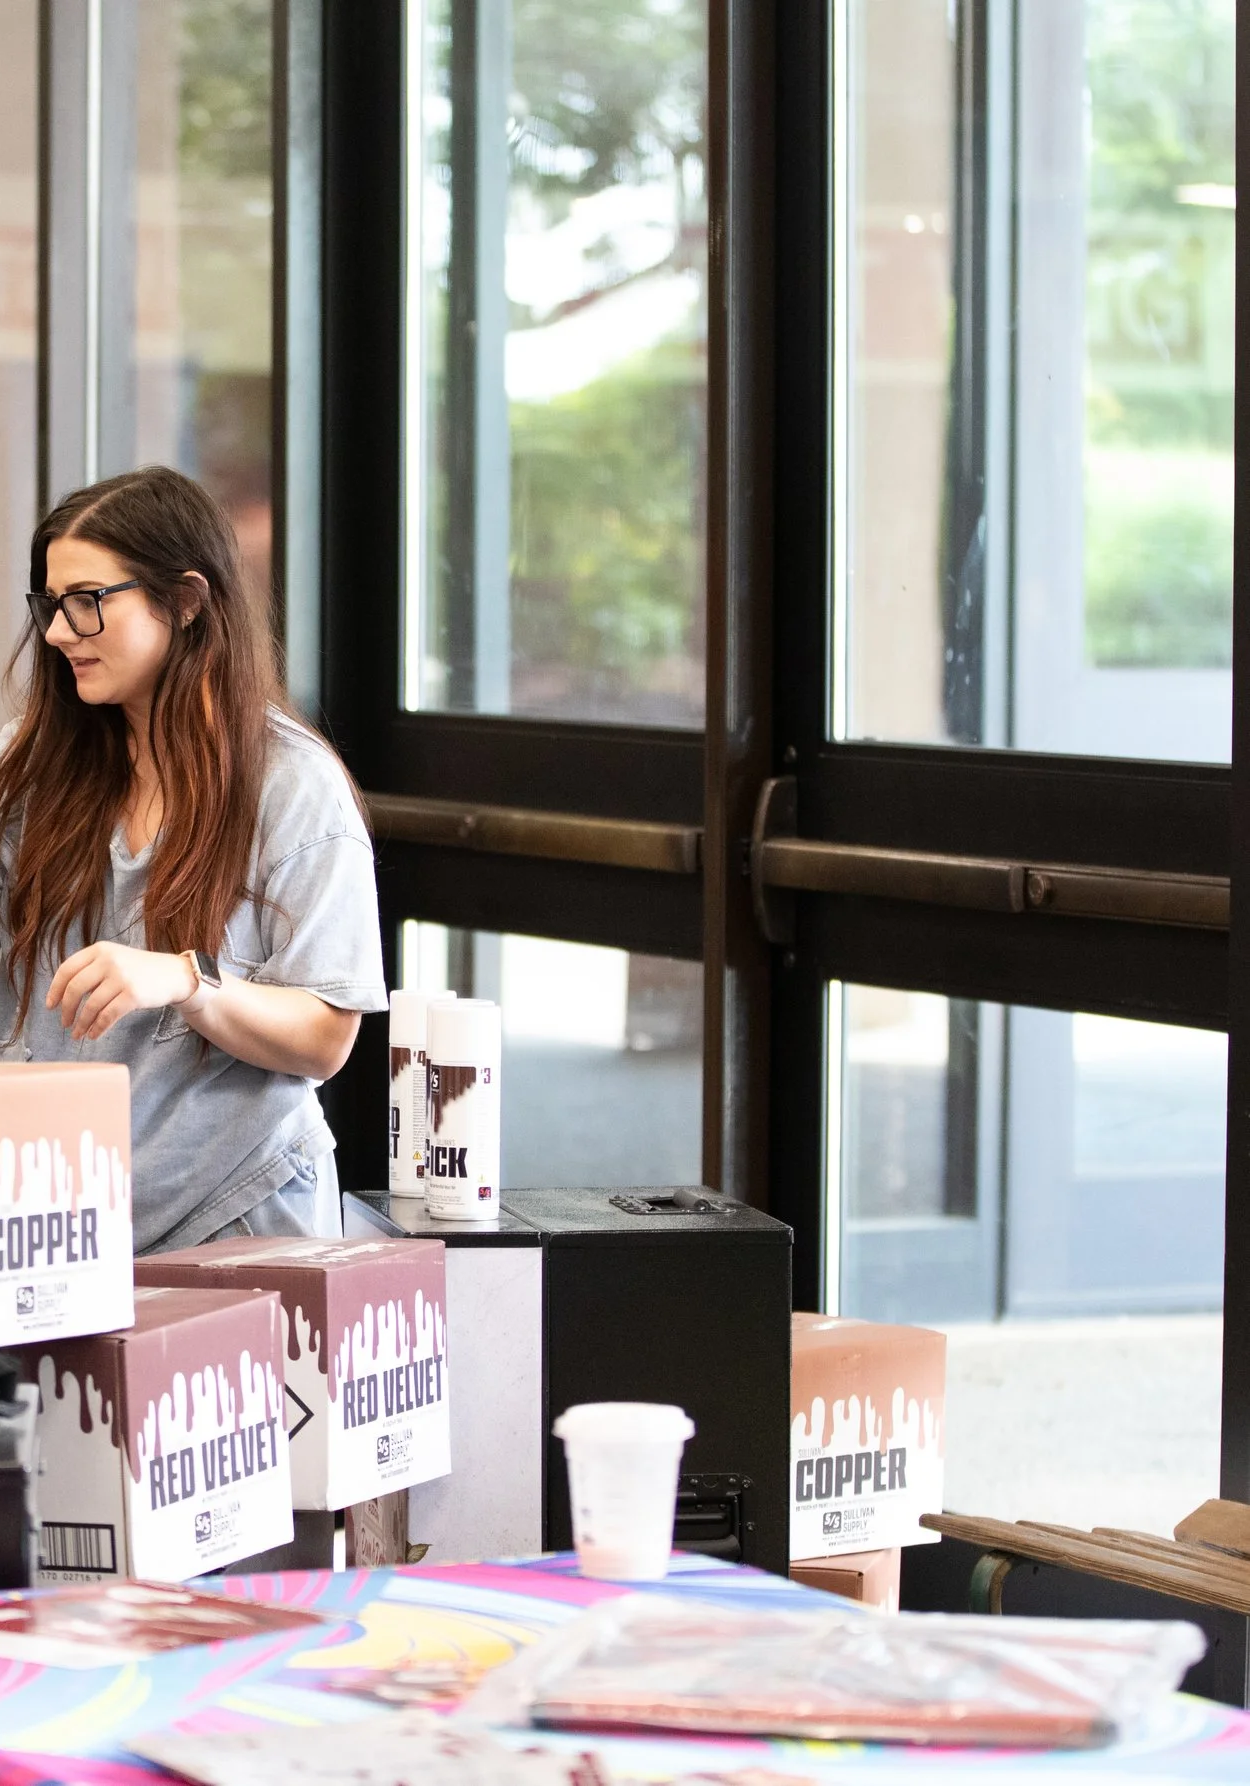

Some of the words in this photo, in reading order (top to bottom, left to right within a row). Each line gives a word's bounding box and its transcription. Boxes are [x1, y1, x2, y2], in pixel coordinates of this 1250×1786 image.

[342, 1373, 379, 1431] RED
[383, 1353, 445, 1418] VELVET
[149, 1446, 195, 1512] RED
[201, 1417, 278, 1493] VELVET
[795, 1446, 907, 1504] COPPER
[842, 1506, 875, 1520] SULLIVAN
[842, 1519, 868, 1533] SUPPLY
